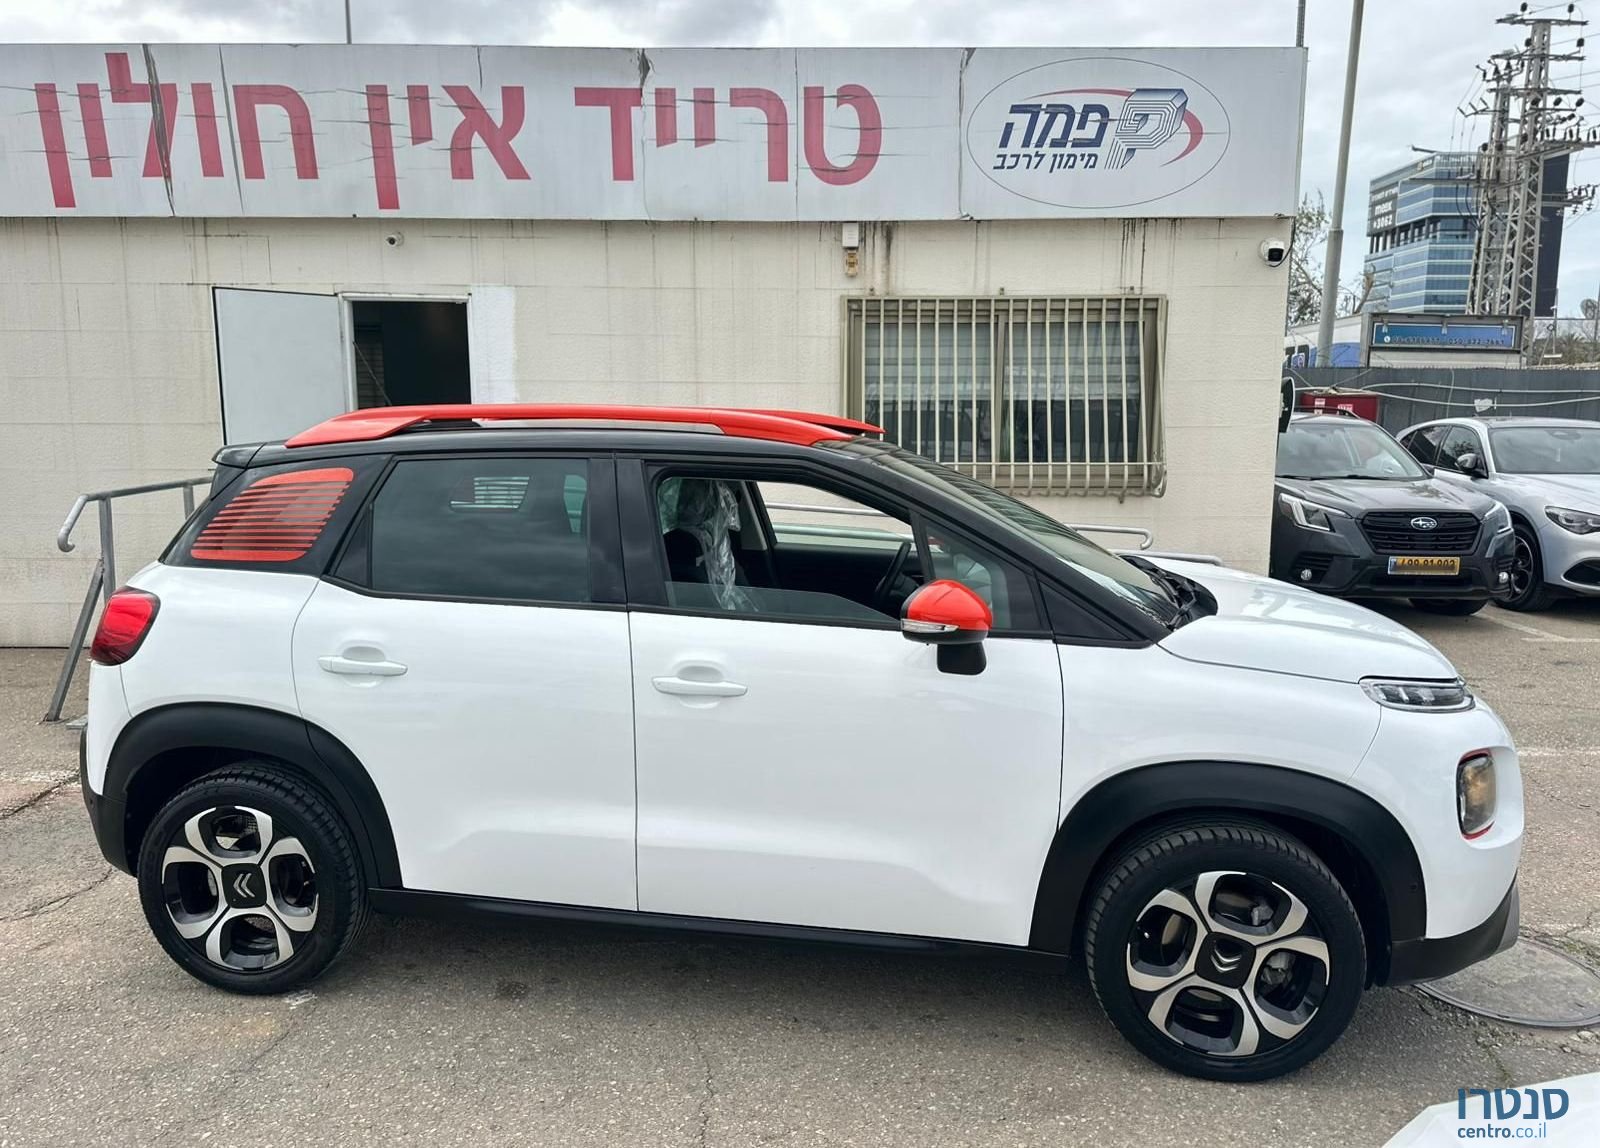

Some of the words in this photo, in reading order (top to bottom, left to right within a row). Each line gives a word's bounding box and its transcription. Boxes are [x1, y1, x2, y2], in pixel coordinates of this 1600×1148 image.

[34, 52, 319, 208] חולון
[365, 84, 531, 210] אין
[574, 83, 882, 186] טרייד
[993, 150, 1046, 170] לרכב
[998, 103, 1110, 149] פמה
[1049, 152, 1099, 174] מימון
